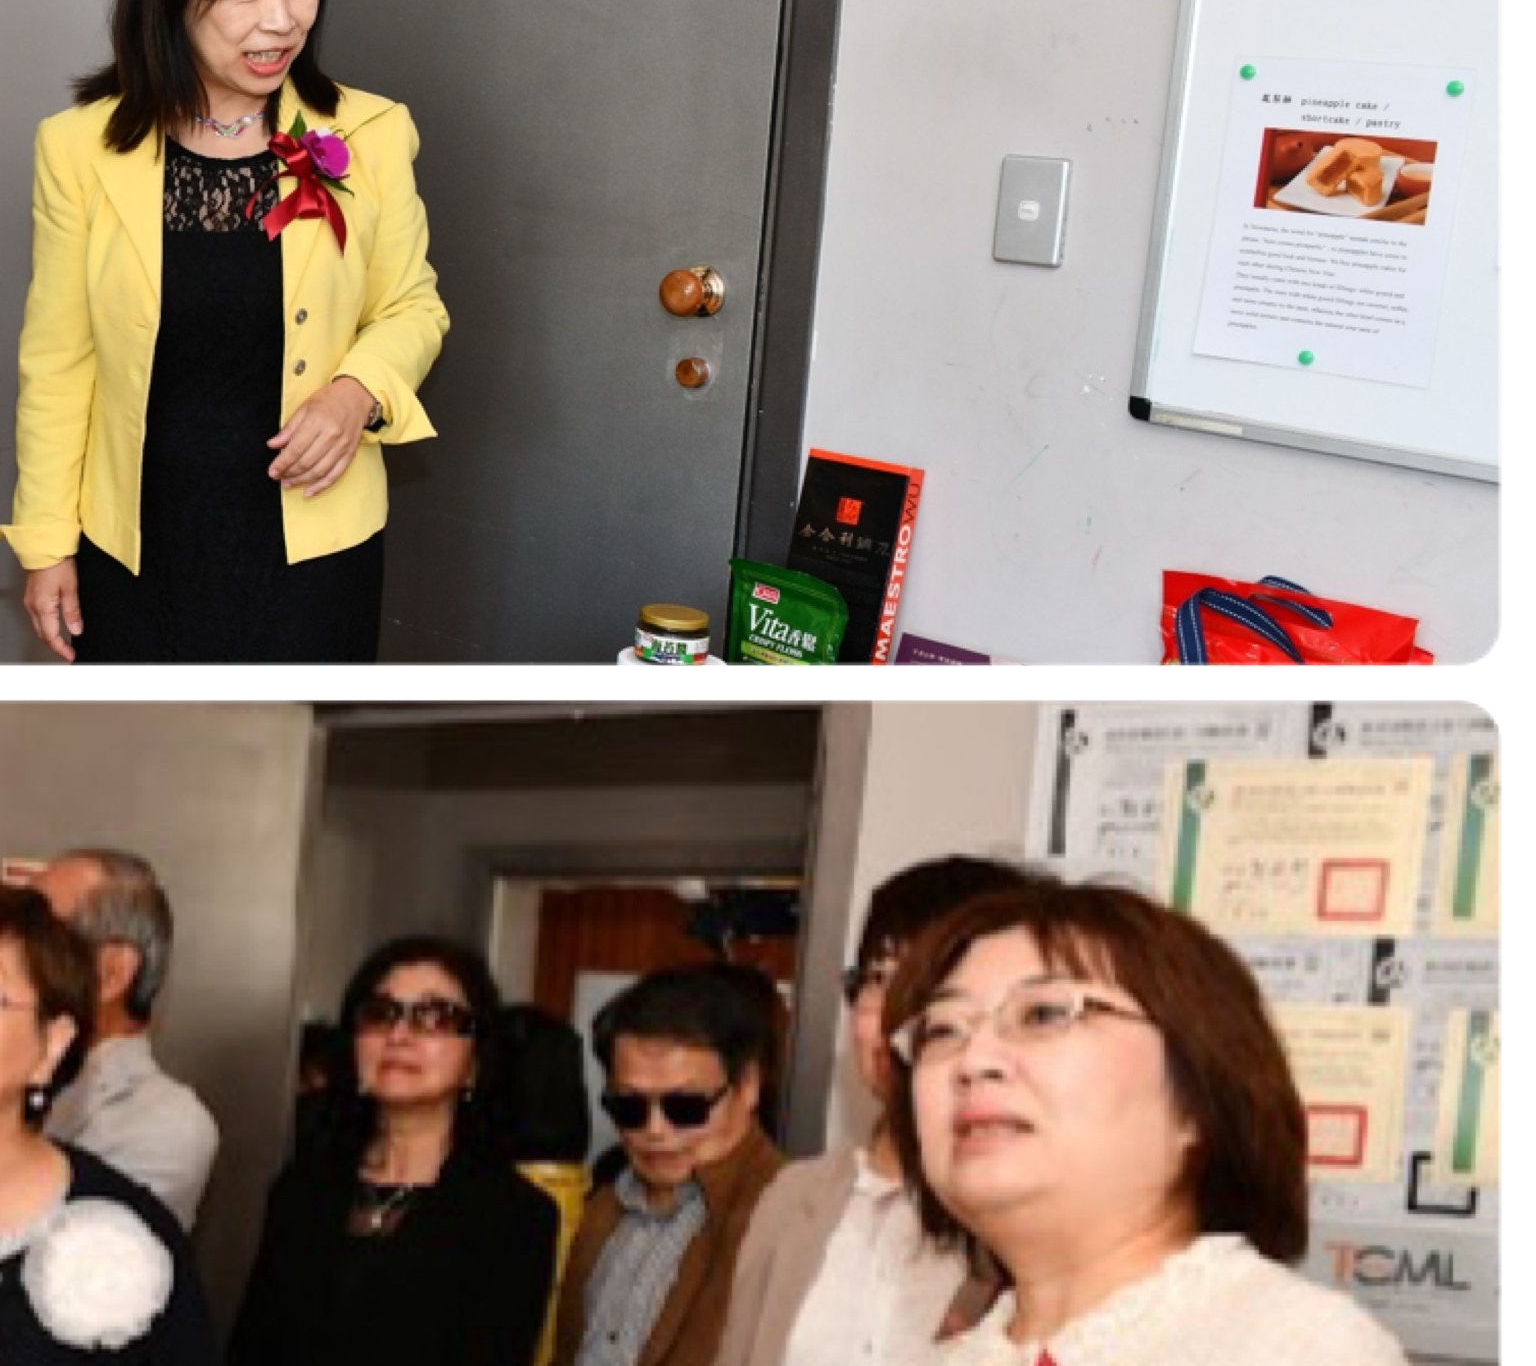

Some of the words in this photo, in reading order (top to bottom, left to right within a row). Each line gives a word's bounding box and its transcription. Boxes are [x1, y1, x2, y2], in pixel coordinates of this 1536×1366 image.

[1301, 97, 1350, 110] pineapple
[1355, 102, 1379, 111] cake
[1301, 113, 1351, 126] shortcake
[1365, 118, 1401, 130] pastry
[875, 524, 912, 661] MAESTRO
[749, 601, 790, 644] Vita
[1326, 1241, 1470, 1290] TCML
